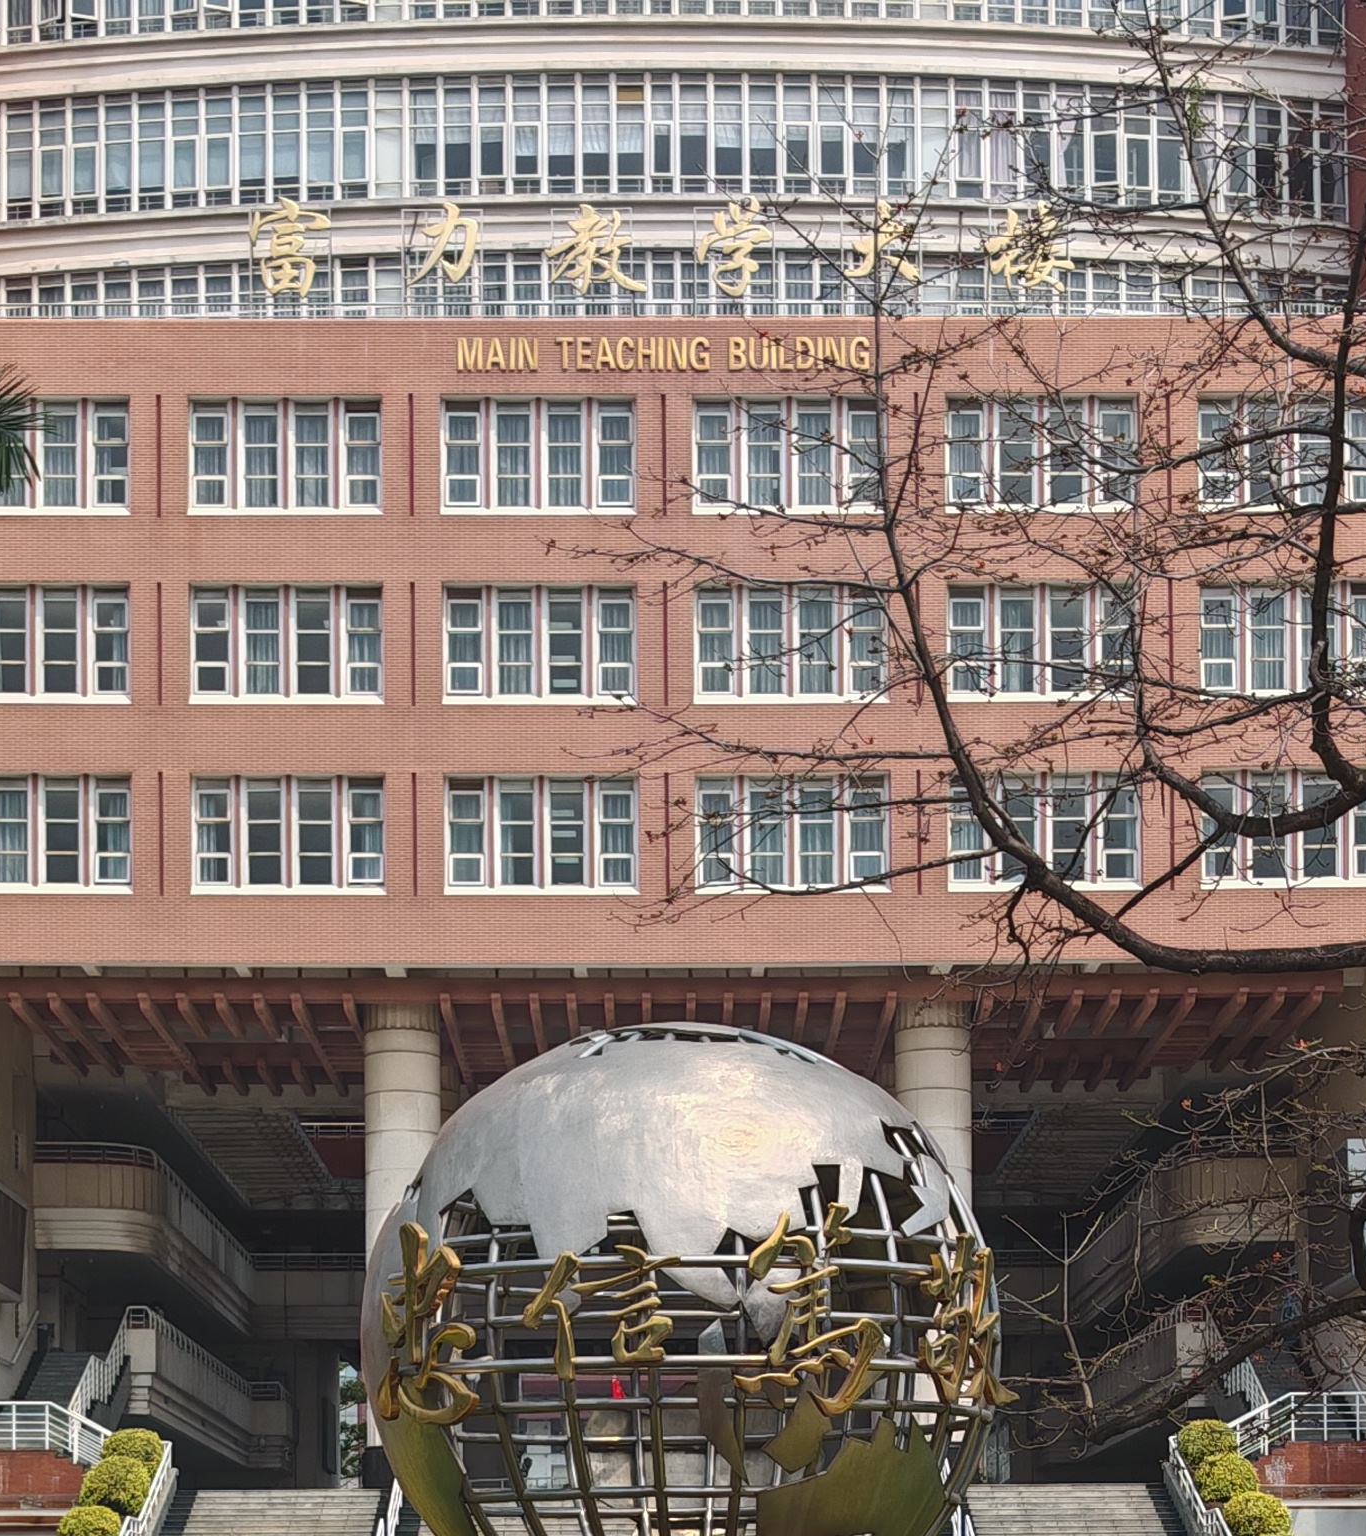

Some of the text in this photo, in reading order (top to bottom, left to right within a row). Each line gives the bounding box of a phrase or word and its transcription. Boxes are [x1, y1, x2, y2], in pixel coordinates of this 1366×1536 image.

[456, 336, 873, 372] MAIN TEACHING BUILDING
